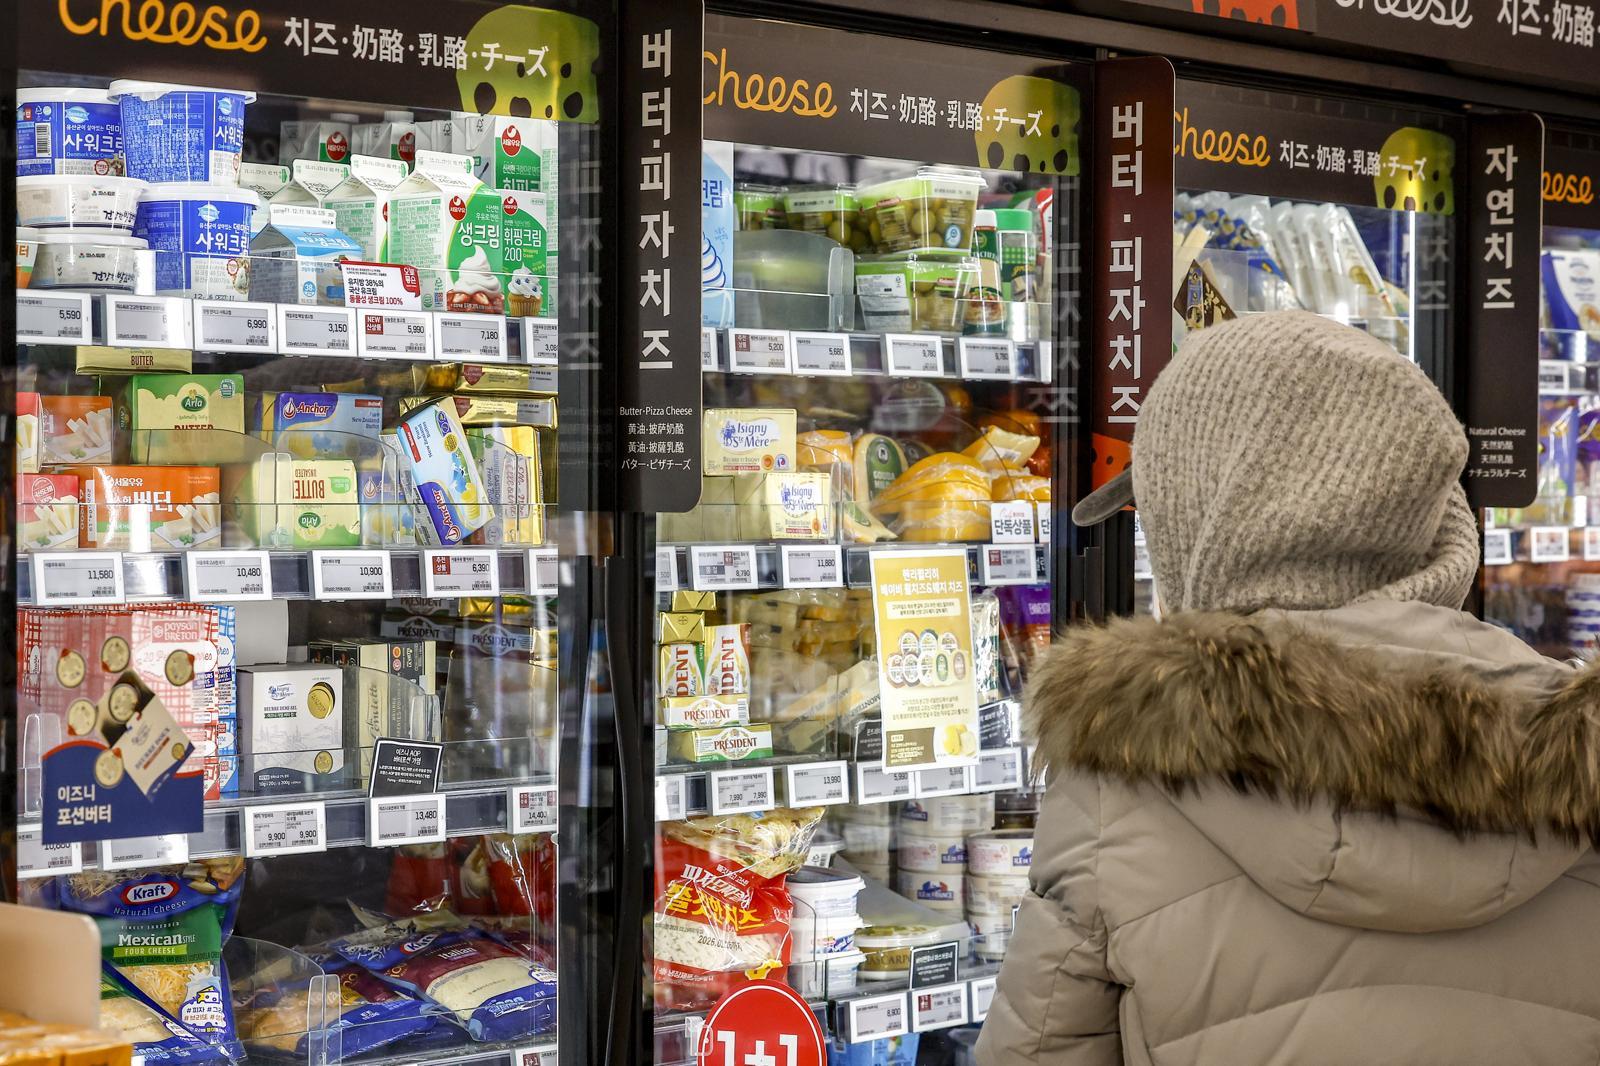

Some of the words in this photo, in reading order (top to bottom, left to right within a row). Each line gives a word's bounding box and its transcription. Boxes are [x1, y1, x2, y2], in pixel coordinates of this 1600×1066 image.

[1483, 145, 1518, 309] 자연치즈
[457, 221, 500, 249] 생크림
[504, 228, 542, 247] 휘핑크림
[196, 232, 249, 257] 사워크림
[504, 247, 522, 262] 200
[348, 278, 365, 287] 유지방
[348, 287, 360, 296] 국산
[361, 287, 378, 296] 유크림
[349, 295, 366, 304] 동물성
[367, 296, 385, 305] 생크림
[386, 297, 403, 305] 100%
[59, 310, 81, 320] 5,590
[247, 319, 267, 329] 6,990
[328, 323, 348, 333] 3,150
[407, 325, 425, 334] 5,990
[481, 331, 498, 340] 7,180
[545, 344, 559, 352] 3,08
[768, 343, 784, 352] 5,200
[131, 356, 154, 366] BUTTER
[185, 397, 203, 409] Arla
[297, 402, 331, 415] Anchor
[666, 406, 693, 416] Cheese
[738, 423, 767, 437] Isigny
[1469, 427, 1496, 436] Natural
[1498, 427, 1526, 436] Cheese
[295, 469, 317, 478] UNSALTED
[1468, 468, 1526, 478] ナチュラルチーズ
[115, 478, 143, 487] 서울우유
[292, 480, 325, 499] BUTTE
[792, 486, 812, 499] Isigny
[134, 490, 173, 512] 버터
[433, 489, 456, 526] Anchor
[301, 516, 318, 525] Arla
[994, 519, 1032, 535] 단독상품
[472, 563, 489, 573] 6,390
[817, 559, 835, 567] 11,880
[88, 569, 113, 580] 11,580
[237, 567, 261, 578] 10,480
[360, 566, 383, 576] 10,900
[472, 634, 516, 648] PRÉSIDENT
[684, 708, 731, 721] PRÉSIDENT
[714, 737, 757, 750] PRÉSIDENT
[396, 749, 409, 757] 이즈니
[823, 775, 841, 785] 13,990
[58, 784, 96, 803] 이즈니
[57, 805, 112, 826] 포션버터
[415, 811, 437, 820] 13,480
[268, 833, 285, 841] 9,900
[300, 829, 317, 838] 9,900
[133, 885, 166, 901] Kraft
[113, 906, 150, 917] Natural
[153, 900, 187, 914] Cheese
[118, 933, 182, 947] Mexican
[182, 934, 195, 943] STYLE
[404, 934, 435, 951] Kraft
[438, 946, 479, 960] Italian
[717, 1031, 798, 1066] 1+1
